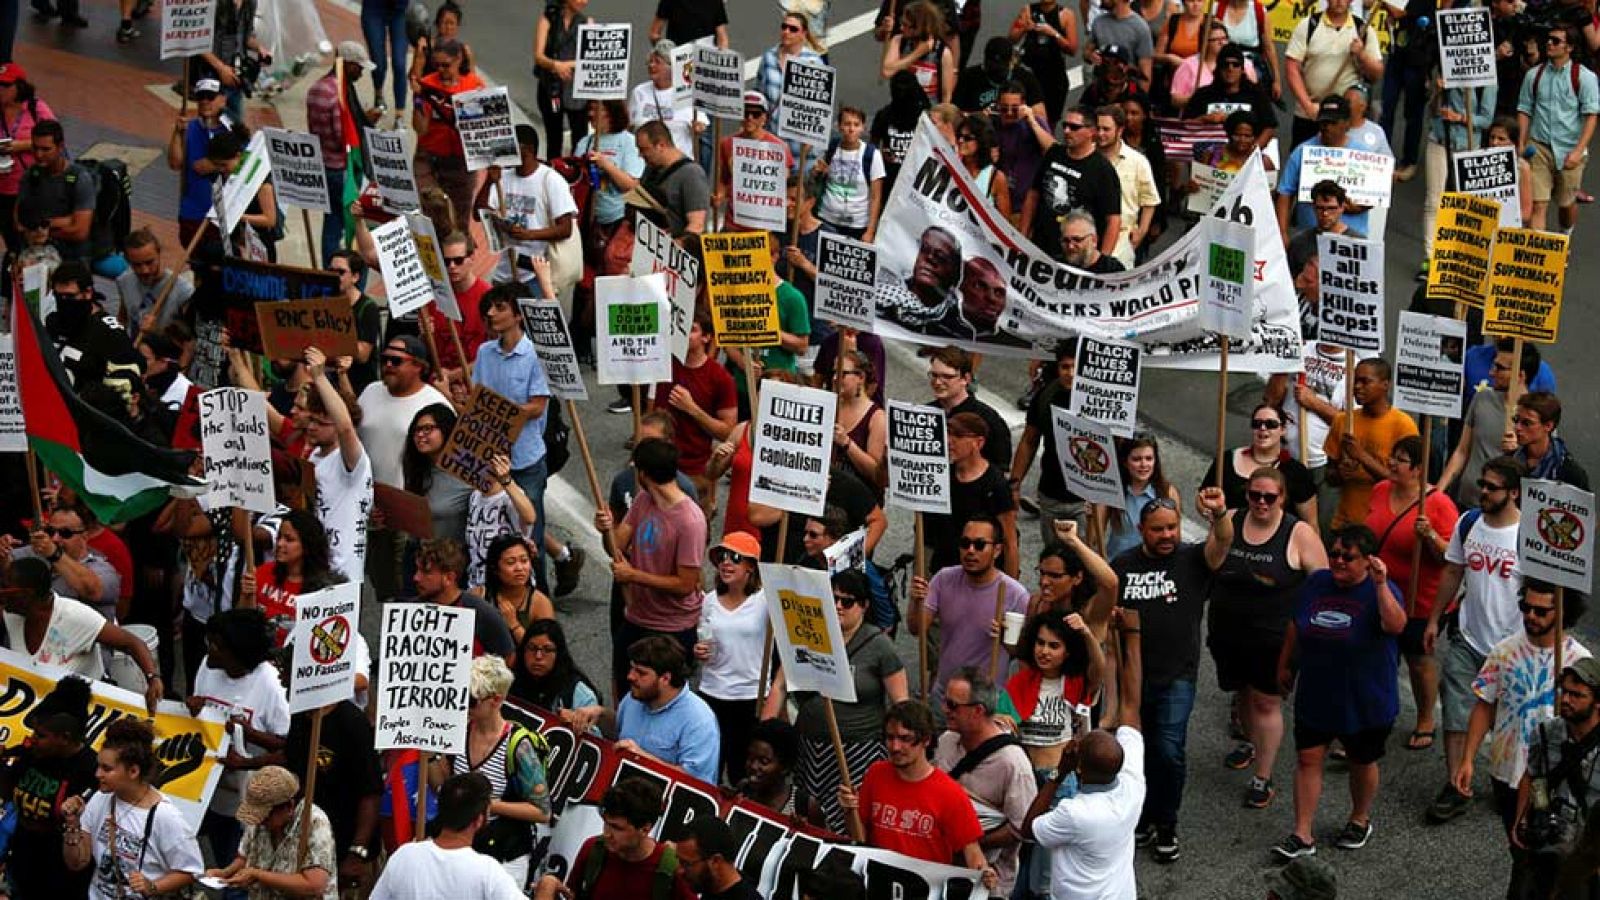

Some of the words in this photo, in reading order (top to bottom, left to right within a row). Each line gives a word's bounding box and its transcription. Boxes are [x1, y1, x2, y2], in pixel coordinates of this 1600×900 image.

[1445, 13, 1485, 24] BLACK
[588, 30, 625, 40] BLACK
[1449, 23, 1482, 33] LIVES
[589, 40, 621, 49] LIVES
[1446, 31, 1489, 45] MATTER
[584, 49, 625, 59] MATTER
[699, 50, 738, 68] UNITE
[1445, 46, 1491, 57] MUSLIM
[582, 63, 624, 71] MUSLIM
[790, 62, 829, 80] BLACK
[1451, 64, 1489, 76] MATTER
[1454, 57, 1484, 67] LIVES
[589, 72, 617, 80] LIVES
[695, 66, 739, 81] against
[791, 74, 826, 90] LIVES
[584, 79, 622, 88] MATTER
[695, 81, 741, 98] capitalism
[787, 84, 831, 101] MATTER
[786, 119, 825, 134] MATTER
[791, 110, 820, 125] LIVES
[271, 138, 316, 158] END
[736, 146, 783, 162] DEFEND
[1309, 148, 1343, 158] NEVER
[1349, 151, 1388, 165] FORGET
[740, 162, 779, 177] BLACK
[1464, 153, 1508, 169] BLACK
[281, 169, 325, 189] RACISM
[1465, 171, 1513, 190] MATTER
[1468, 164, 1506, 179] LIVES
[742, 178, 777, 191] LIVES
[736, 191, 783, 208] MATTER
[1440, 195, 1467, 210] STAND
[1468, 199, 1498, 219] AGAINST
[1455, 211, 1482, 231] WHITE
[704, 238, 729, 252] STAND
[731, 237, 766, 250] AGAINST
[1329, 238, 1368, 261] Jail
[1497, 230, 1526, 246] STAND
[1527, 233, 1566, 252] AGAINST
[826, 240, 870, 261] BLACK
[1513, 248, 1546, 266] WHITE
[723, 254, 752, 269] WHITE
[829, 251, 867, 270] LIVES
[1336, 259, 1360, 276] all
[711, 270, 771, 286] SUPREMACY,
[824, 262, 872, 283] MATTER
[1437, 261, 1486, 281] IMMIGRANT
[1493, 262, 1560, 287] SUPREMACY,
[1322, 270, 1379, 295] Racist
[1440, 272, 1480, 291] BASHING!
[713, 293, 773, 307] ISLAMOPHOBIA,
[830, 290, 862, 308] LIVES
[1011, 276, 1102, 318] WORKERS
[1109, 283, 1174, 318] WORLD
[1323, 292, 1377, 316] Killer
[1492, 284, 1556, 306] ISLAMOPHOBIA,
[617, 304, 649, 314] SHUT
[720, 306, 770, 319] IMMIGRANT
[824, 298, 869, 316] MATTER
[1495, 298, 1552, 315] IMMIGRANT
[275, 309, 312, 329] RNC
[616, 314, 651, 324] DOWN
[726, 319, 767, 331] BASHING!
[1321, 308, 1378, 332] Cops!
[1498, 309, 1546, 328] BASHING!
[614, 323, 653, 334] TRUMP
[611, 337, 634, 347] AND
[637, 336, 656, 346] THE
[1086, 340, 1132, 360] BLACK
[1088, 353, 1129, 371] LIVES
[1083, 365, 1133, 384] MATTER
[1076, 381, 1136, 402] MIGRANTS'
[202, 390, 248, 418] STOP
[477, 387, 520, 420] KEEP
[770, 397, 824, 425] UNITE
[1085, 395, 1122, 411] LIVES
[893, 409, 938, 428] BLACK
[1080, 405, 1128, 421] MATTER
[204, 421, 225, 438] the
[763, 422, 824, 448] against
[896, 422, 934, 440] LIVES
[1057, 417, 1072, 431] NO
[1073, 427, 1109, 444] racism
[224, 436, 246, 452] and
[894, 436, 941, 454] MATTER
[760, 447, 822, 473] capitalism
[890, 456, 947, 474] MIGRANTS'
[901, 470, 935, 487] LIVES
[897, 481, 942, 496] MATTER
[1527, 487, 1547, 503] NO
[1549, 498, 1589, 517] racism
[1525, 537, 1543, 551] NO
[1544, 545, 1586, 568] Fascism
[1468, 551, 1515, 580] OVE
[1126, 571, 1167, 586] TUCK
[301, 605, 320, 620] NO
[322, 602, 355, 618] racism
[387, 608, 459, 633] FIGHT
[385, 634, 458, 660] RACISM
[460, 643, 471, 654] +
[297, 665, 313, 679] NO
[314, 661, 351, 676] Fascism
[389, 661, 458, 684] POLICE
[386, 685, 468, 711] TERROR!
[423, 716, 457, 731] Power
[393, 731, 453, 749] Assembly
